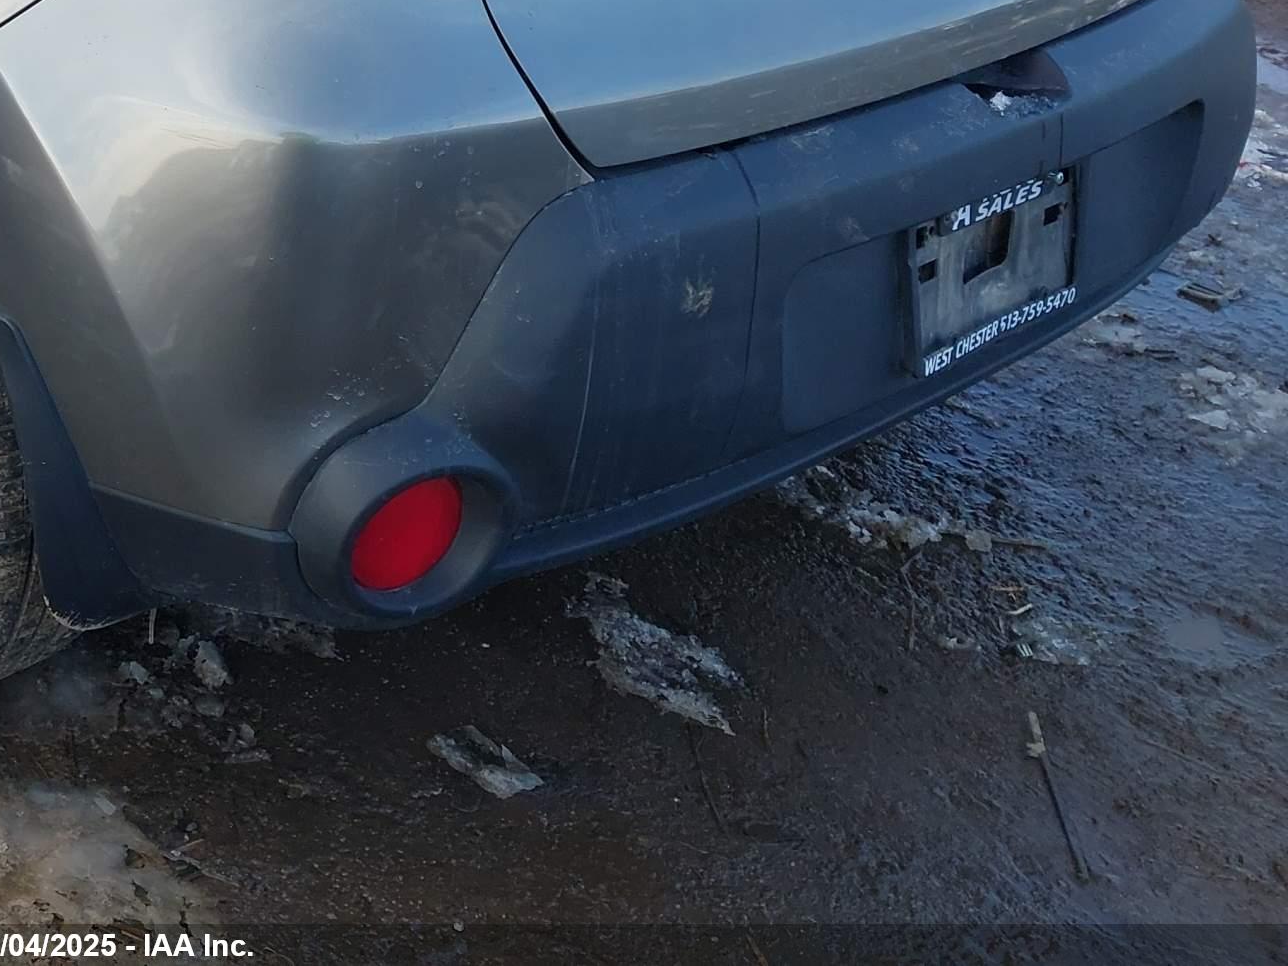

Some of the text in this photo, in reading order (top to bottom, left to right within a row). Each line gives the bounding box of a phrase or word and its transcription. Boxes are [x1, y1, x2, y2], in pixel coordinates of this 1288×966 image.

[975, 179, 1044, 222] SALES
[923, 346, 954, 377] WEST
[955, 320, 1000, 359] CHESTER
